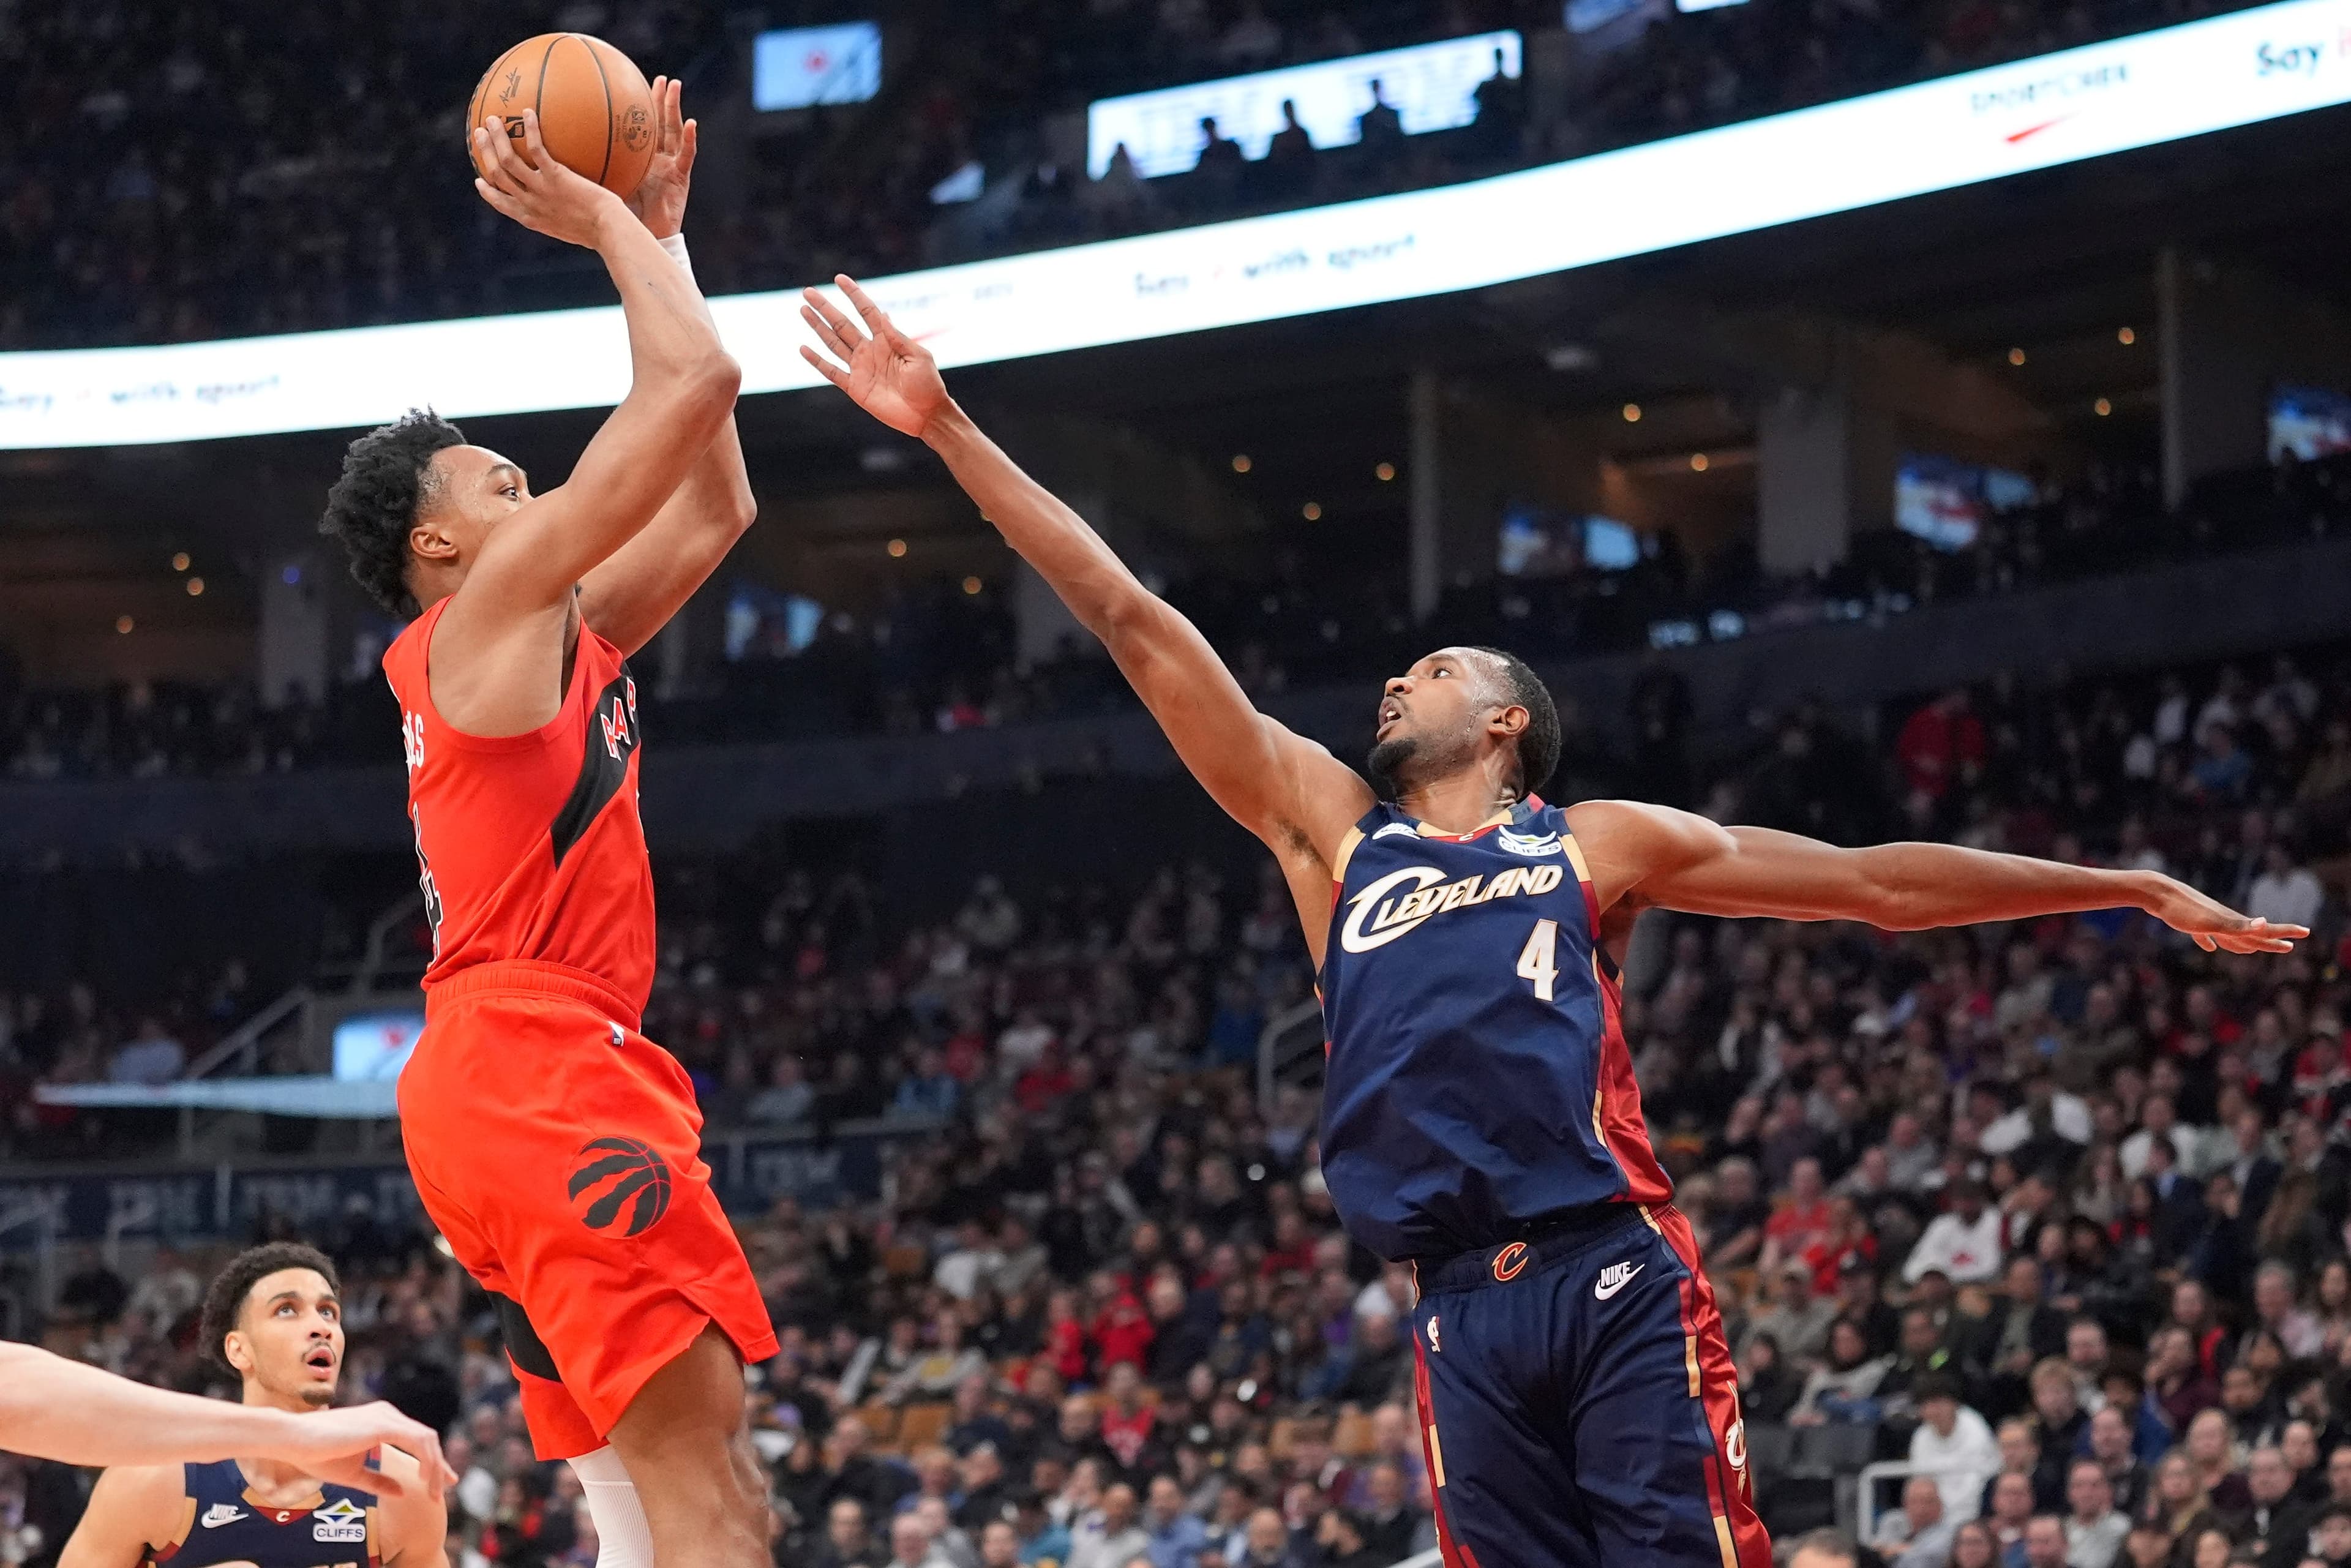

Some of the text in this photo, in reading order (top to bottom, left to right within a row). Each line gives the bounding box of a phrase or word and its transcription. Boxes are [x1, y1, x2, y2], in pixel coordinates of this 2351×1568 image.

[2255, 39, 2325, 78] Say
[1501, 840, 1559, 854] CLIFFS
[1341, 865, 1563, 953] CLEVELAND
[1517, 918, 1560, 1002] 4
[1600, 1261, 1631, 1287] NIKE
[316, 1528, 363, 1539] CLIFFS
